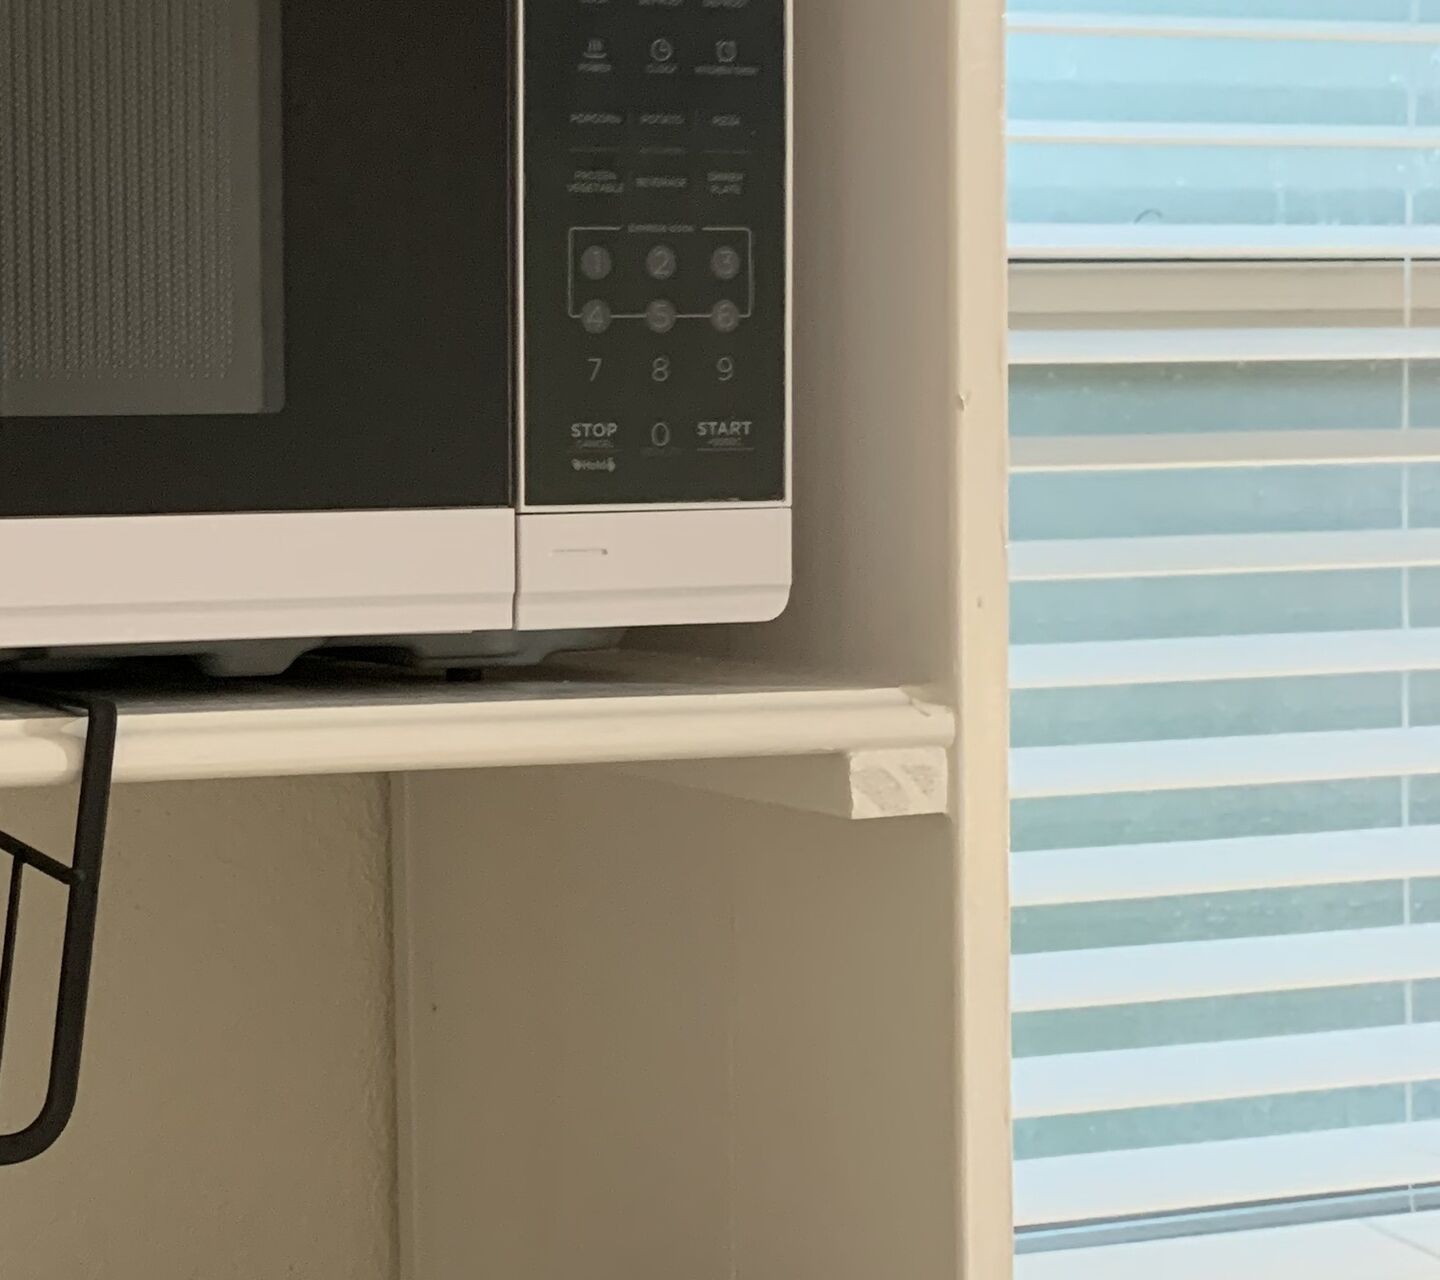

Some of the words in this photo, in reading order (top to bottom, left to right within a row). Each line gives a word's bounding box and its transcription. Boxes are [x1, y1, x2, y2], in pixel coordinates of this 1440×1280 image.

[588, 357, 603, 382] 7
[651, 357, 669, 382] 8
[716, 357, 734, 382] 9
[570, 422, 618, 438] STOP
[650, 422, 670, 447] 0
[696, 421, 752, 437] START
